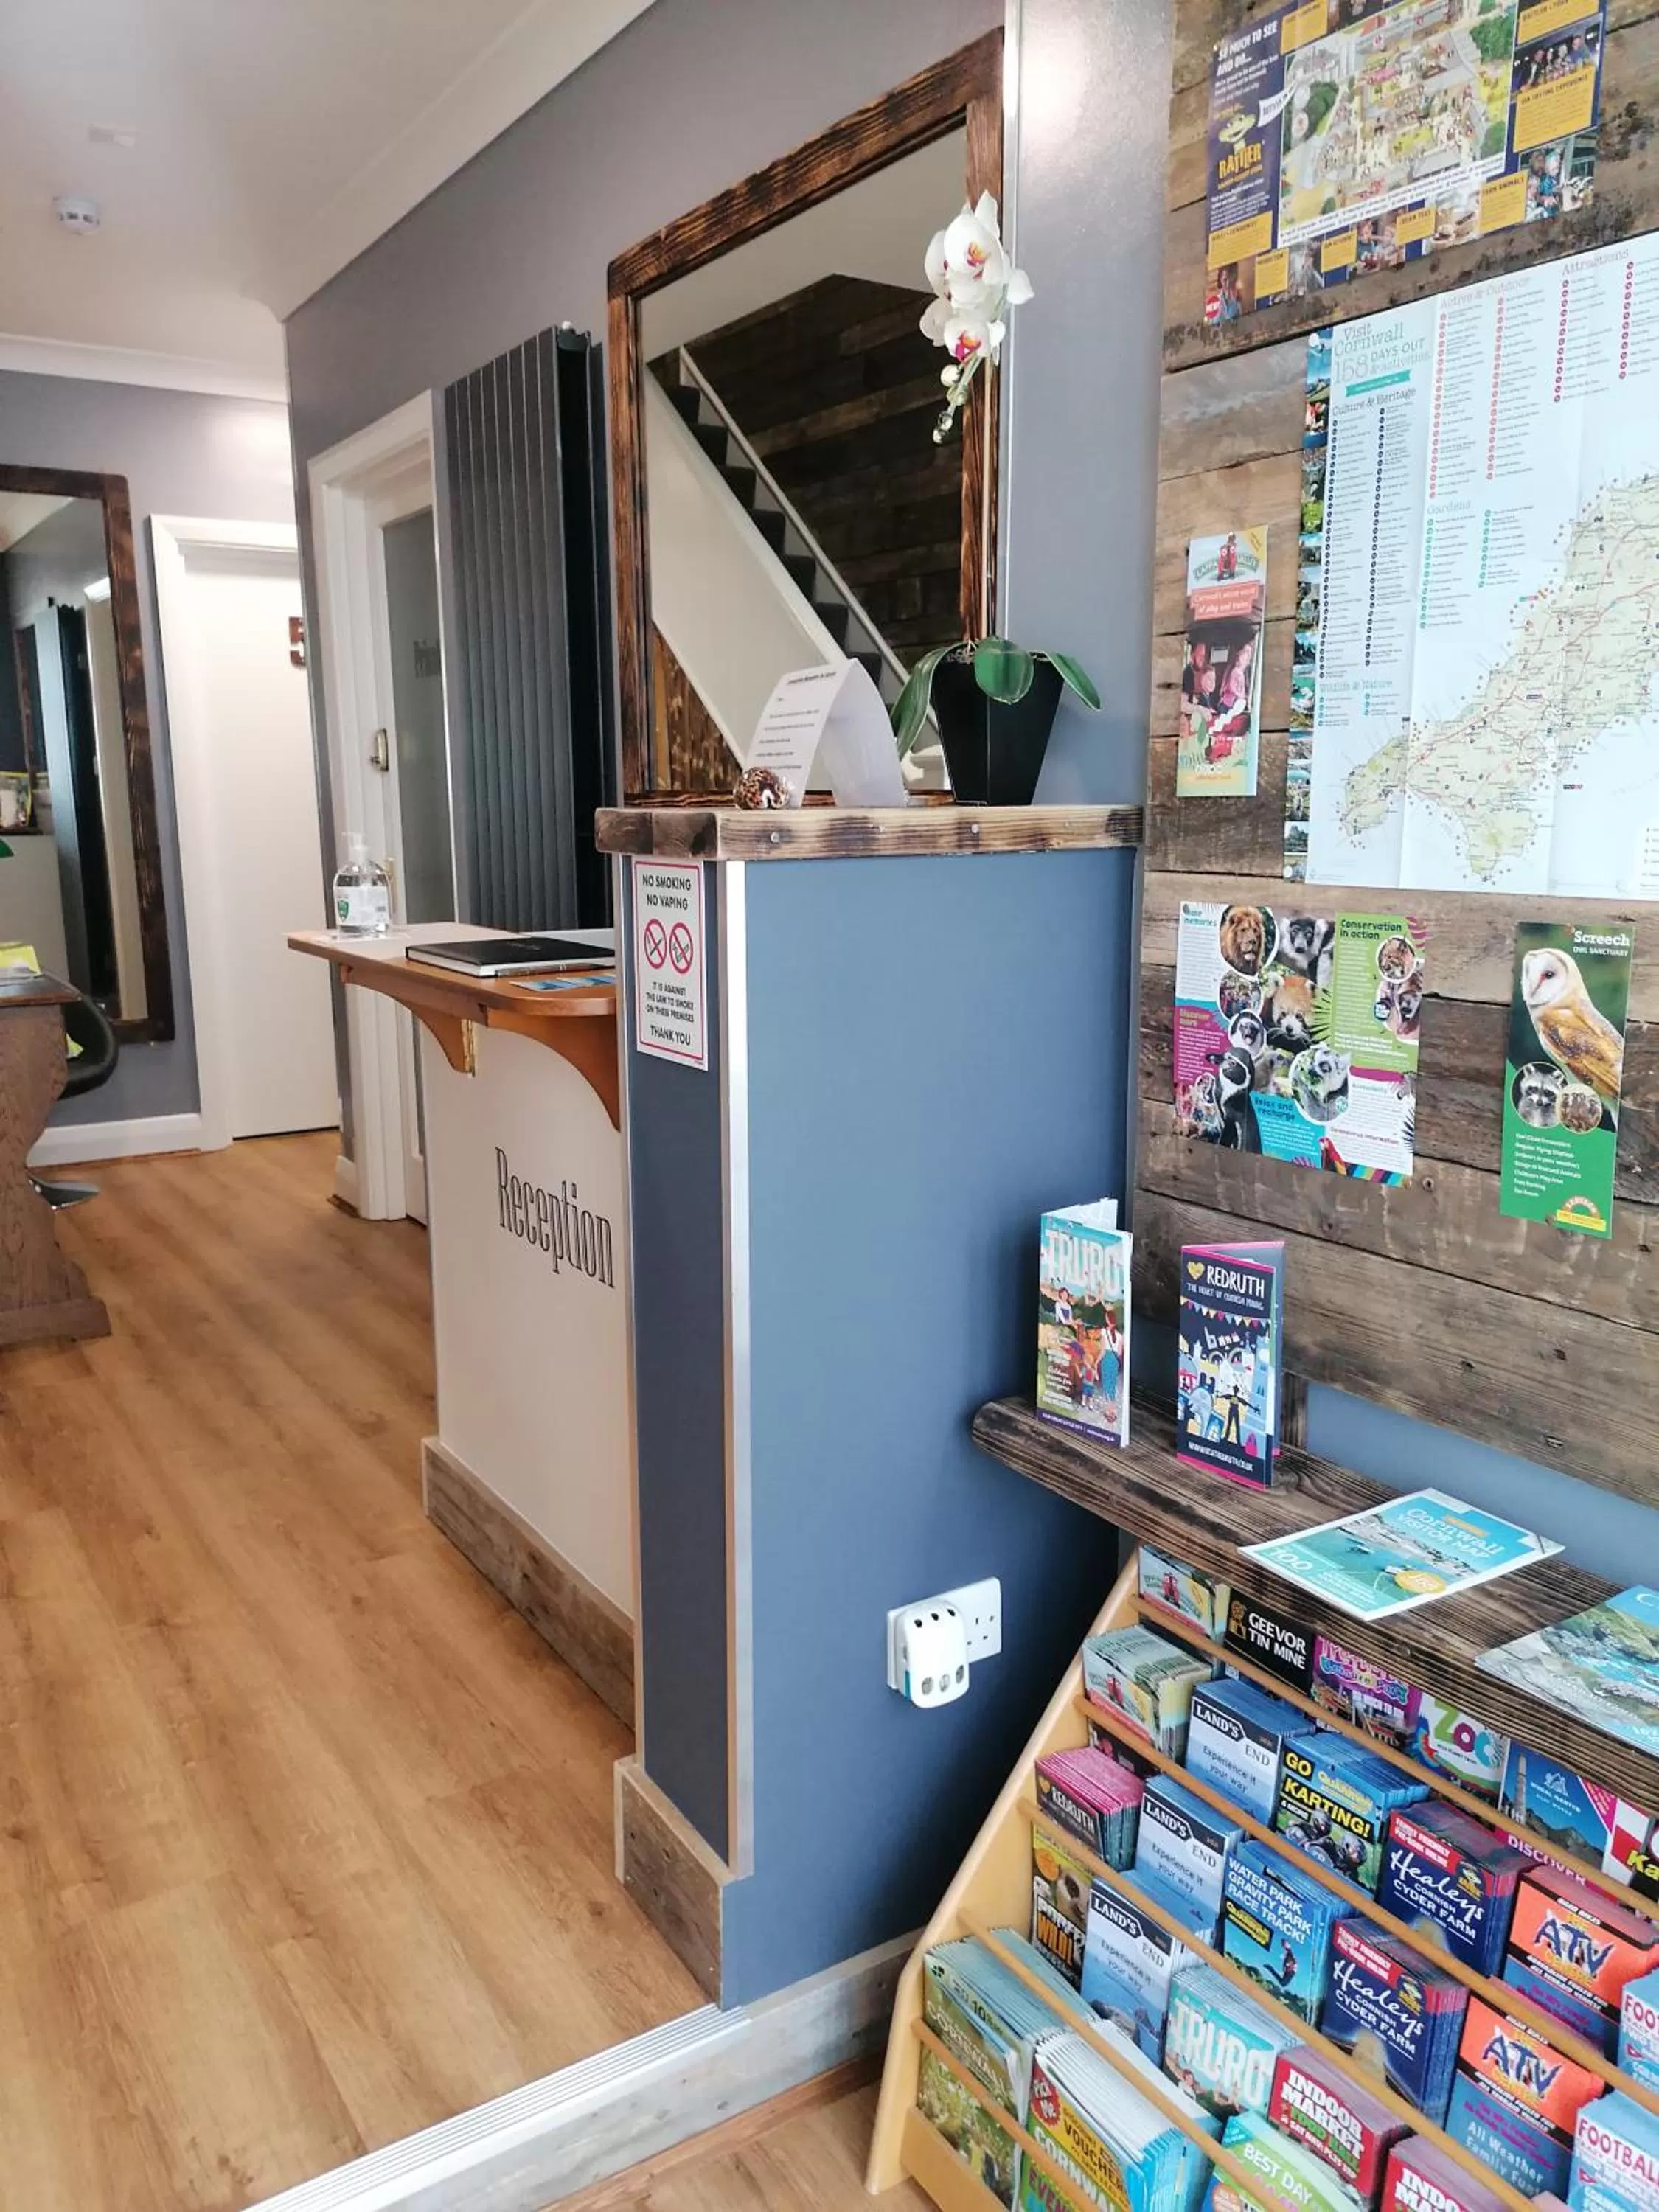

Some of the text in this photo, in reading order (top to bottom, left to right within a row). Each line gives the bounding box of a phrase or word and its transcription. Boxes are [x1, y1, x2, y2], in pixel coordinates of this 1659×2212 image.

[1252, 29, 1262, 44] TO
[1263, 21, 1278, 38] SEE
[1219, 142, 1262, 179] RATTLER
[1562, 248, 1629, 275] Attractions
[1441, 293, 1471, 309] Active
[1335, 322, 1404, 356] Cornwall
[1344, 324, 1372, 341] Visit
[1371, 338, 1425, 362] DAYS OUT
[1332, 401, 1365, 417] Culture
[1377, 388, 1416, 406] Heritage
[1427, 501, 1470, 515] Gardens
[642, 874, 691, 891] NO SMOKING
[647, 894, 688, 910] NO VAPING
[1341, 919, 1402, 931] Conservation
[1350, 931, 1380, 940] action
[1573, 931, 1630, 947] Screech
[1589, 947, 1628, 956] SANCTUARY
[645, 992, 694, 1010] THE LAW TO SMOKE
[664, 984, 686, 995] AGAINST
[646, 1004, 694, 1023] ON THESE PREMISES
[650, 1025, 691, 1046] THANK YOU
[1254, 1097, 1293, 1111] Relax and
[1259, 1108, 1295, 1121] recharge
[495, 1147, 615, 1289] Reception
[1045, 1229, 1119, 1292] TRURO
[1207, 1265, 1265, 1298] REDRUTH
[1406, 1508, 1505, 1555] Cornwall
[1248, 1613, 1307, 1655] GEEVOR
[1248, 1628, 1306, 1670] TIN MINE
[1196, 1705, 1239, 1738] LAND'S
[1203, 1746, 1256, 1785] Experience it
[1246, 1745, 1270, 1765] END
[1286, 1752, 1312, 1777] GO
[1210, 1764, 1248, 1793] your way
[1146, 1802, 1186, 1837] LAND'S
[1285, 1778, 1371, 1838] KARTING!
[1152, 1843, 1203, 1886] Experience it
[1193, 1845, 1216, 1868] END
[1158, 1863, 1194, 1893] your way
[1229, 1857, 1303, 1915] WATER PARK
[1391, 1849, 1484, 1922] Healeys
[1228, 1885, 1259, 1913] RACE
[1262, 1907, 1305, 1944] TRACK!
[1229, 1871, 1277, 1910] GRAVITY
[1279, 1906, 1312, 1935] PARK
[1394, 1880, 1475, 1939] CYDER FARM
[1415, 1883, 1456, 1913] CORNISH
[1094, 1898, 1136, 1934] LAND'S
[1144, 1943, 1165, 1968] END
[1534, 1911, 1615, 1978] ATV
[1333, 1960, 1424, 2038] Healeys
[1355, 1994, 1397, 2028] CORNISH
[1335, 1990, 1416, 2053] CYDER FARM
[1175, 1997, 1265, 2105] TRURO
[1481, 2031, 1562, 2097] ATV
[1281, 2082, 1364, 2157] MARKET
[1290, 2068, 1363, 2138] INDOOR
[1465, 2136, 1506, 2175] Family
[1468, 2121, 1544, 2183] All Weather
[1244, 2142, 1277, 2176] BEST
[1283, 2172, 1312, 2204] DAY
